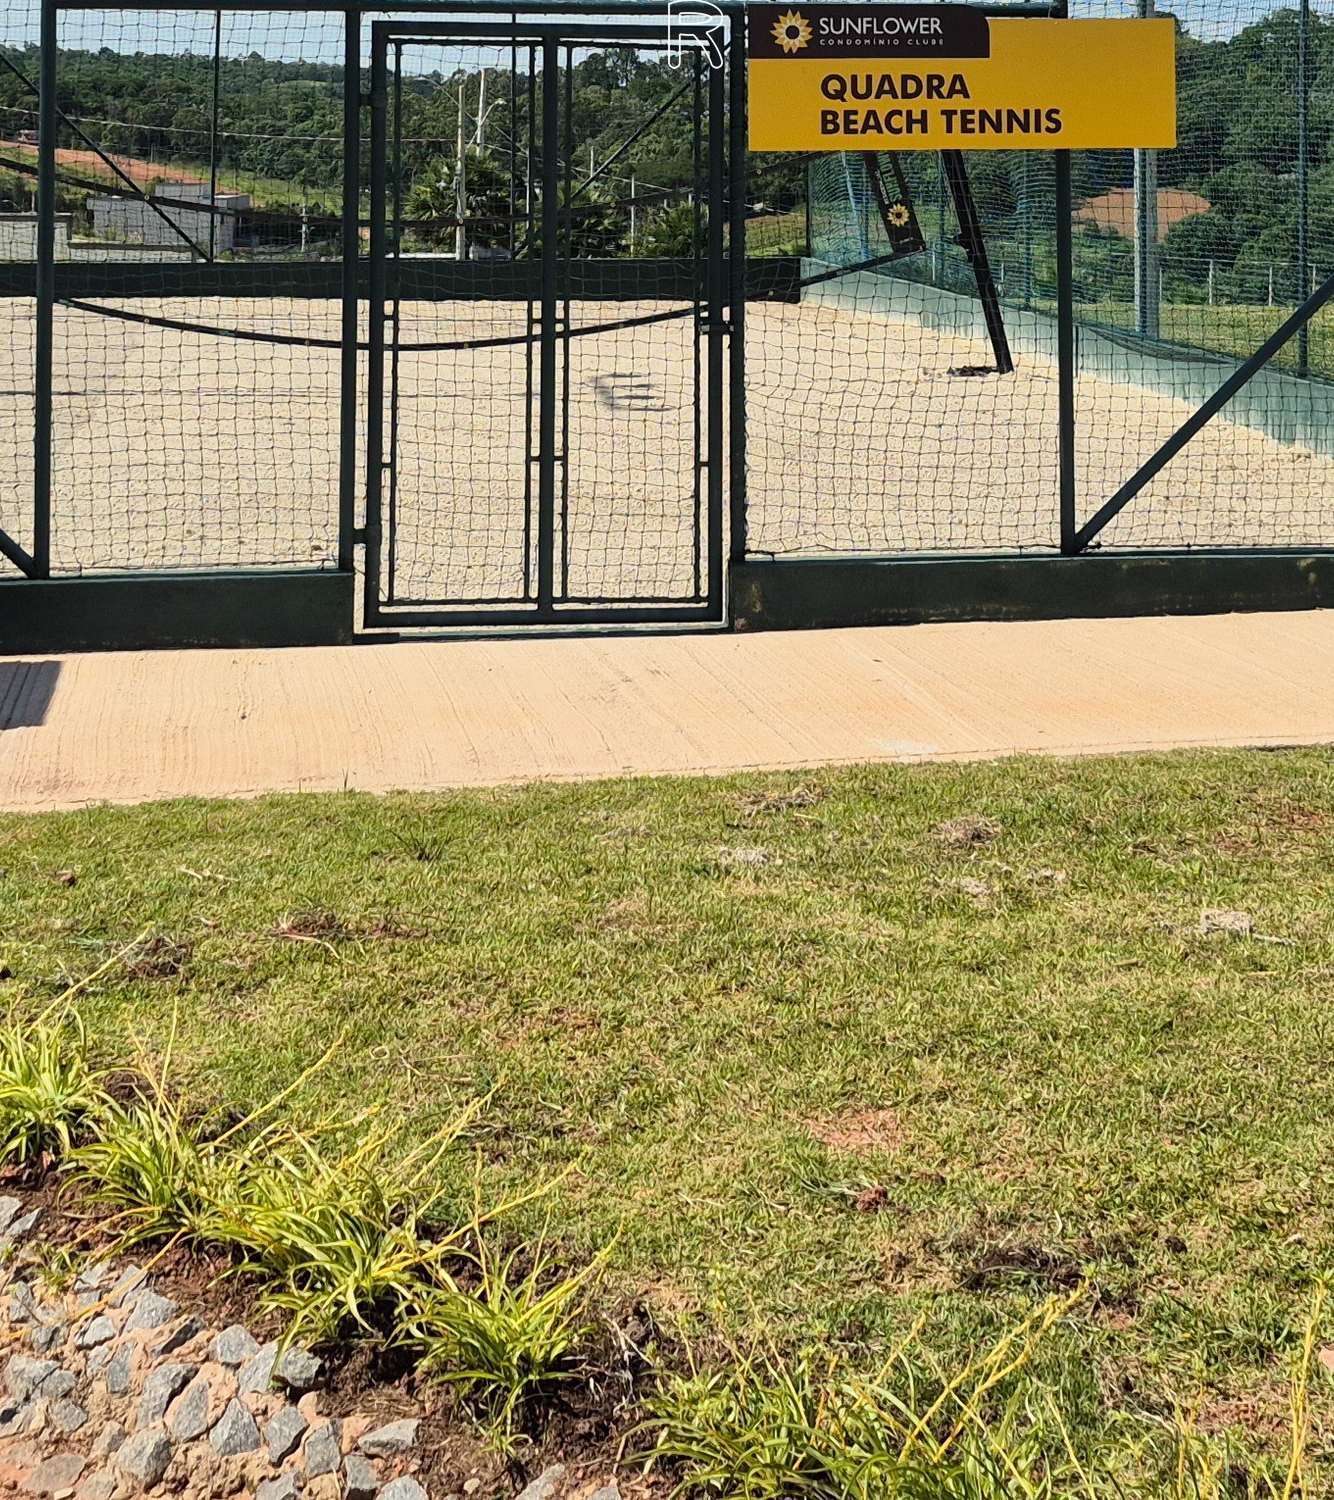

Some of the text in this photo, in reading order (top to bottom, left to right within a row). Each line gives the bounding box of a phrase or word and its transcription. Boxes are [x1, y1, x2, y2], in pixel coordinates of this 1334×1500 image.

[819, 17, 943, 35] SUNFLOWER
[819, 37, 900, 45] CONDOMÍNIO
[820, 73, 971, 102] QUADRA
[820, 108, 1062, 135] BEACH TENNIS
[877, 149, 903, 203] SUNFLOW
